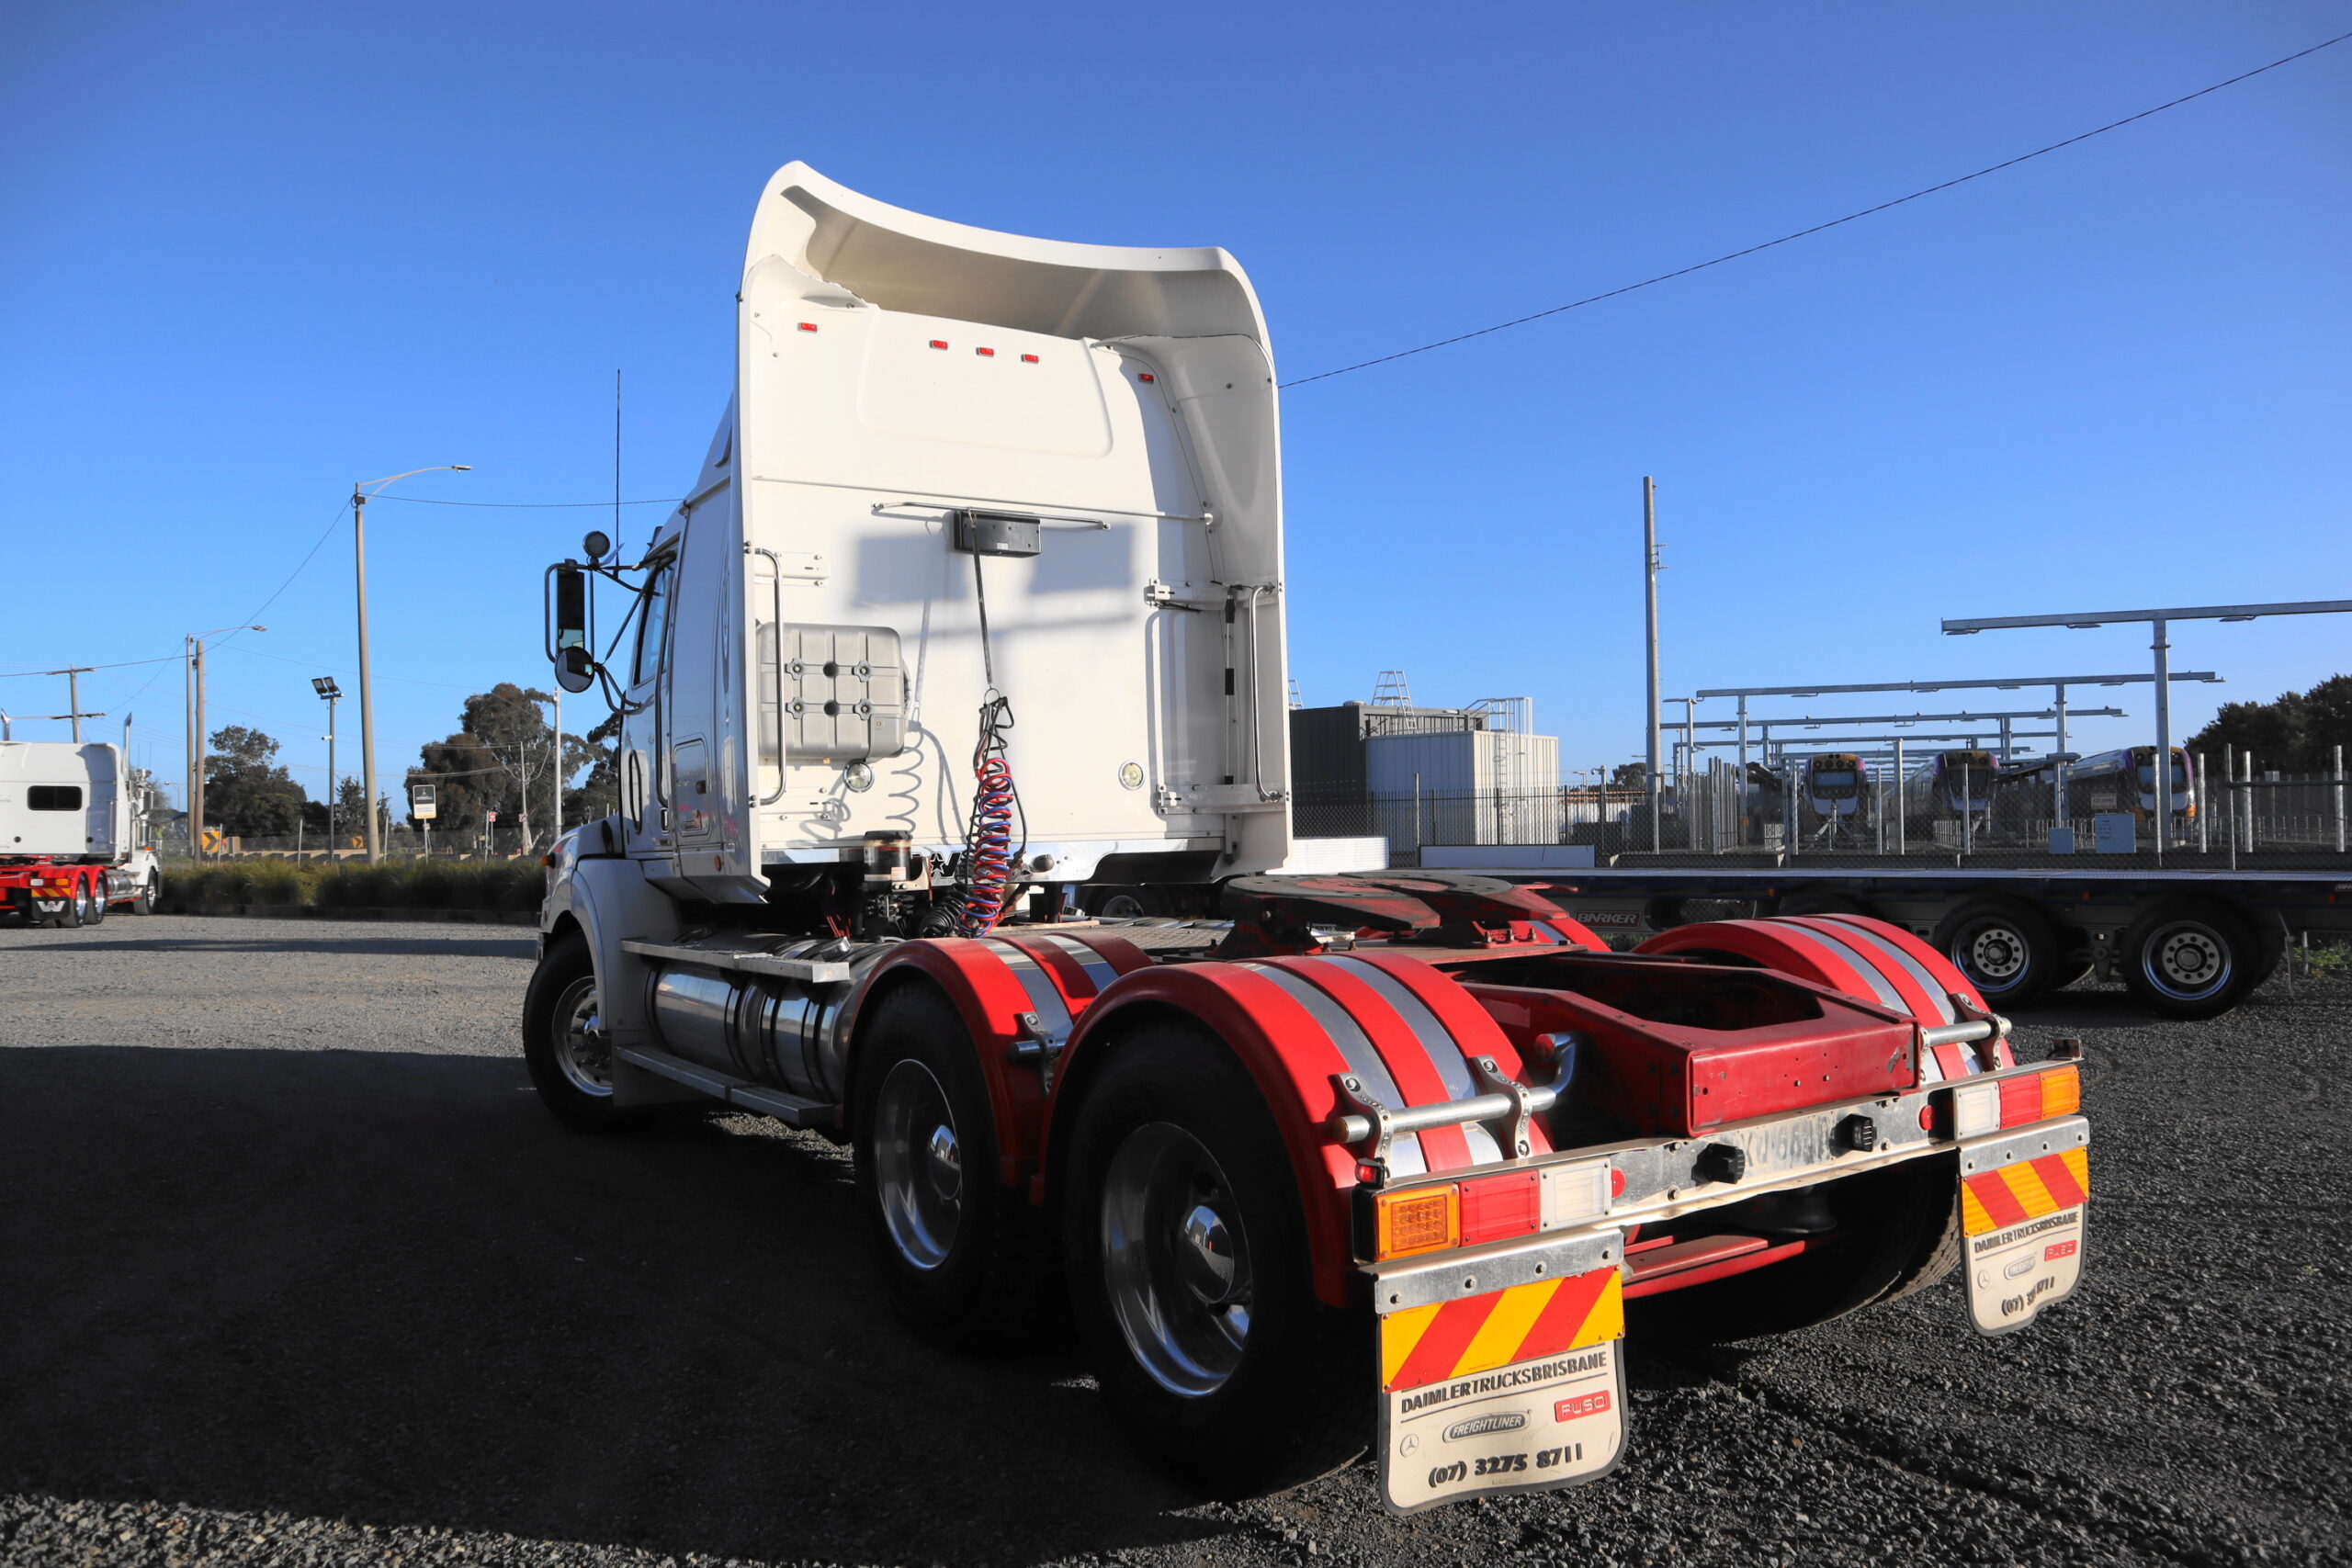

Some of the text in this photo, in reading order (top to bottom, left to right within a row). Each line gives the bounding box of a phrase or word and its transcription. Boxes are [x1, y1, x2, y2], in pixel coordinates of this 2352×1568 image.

[1578, 913, 1636, 923] BARKER
[1562, 1395, 1606, 1416] FUSO
[1453, 1416, 1521, 1437] FREIGHTLINER
[1429, 1443, 1583, 1488] (07) 3275 8711
